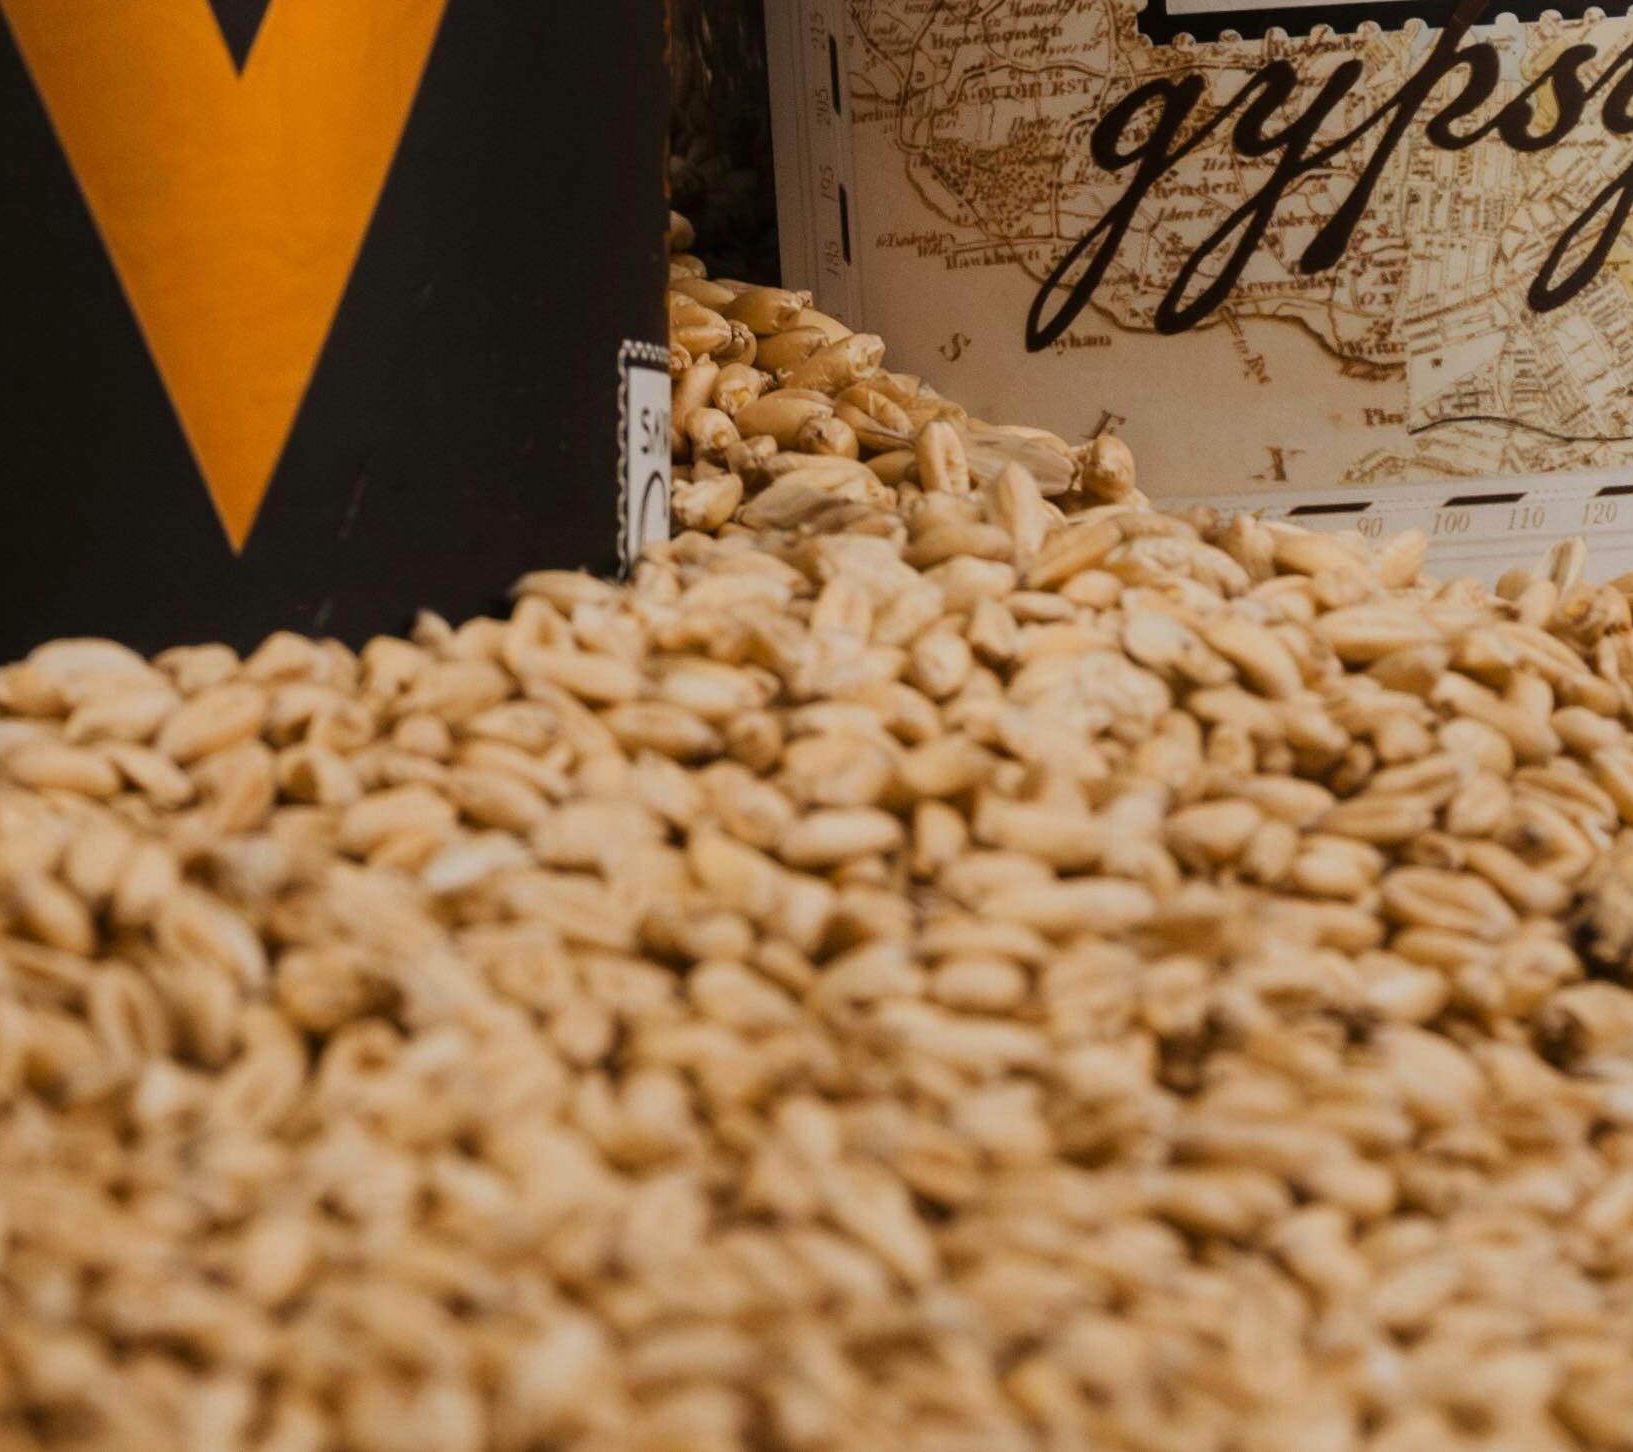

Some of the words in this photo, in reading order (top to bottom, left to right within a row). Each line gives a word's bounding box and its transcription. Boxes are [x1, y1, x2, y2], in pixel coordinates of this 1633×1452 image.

[1356, 516, 1383, 538] 90
[1431, 511, 1471, 536] 100
[1507, 506, 1546, 530] 110
[1581, 501, 1618, 525] 120
